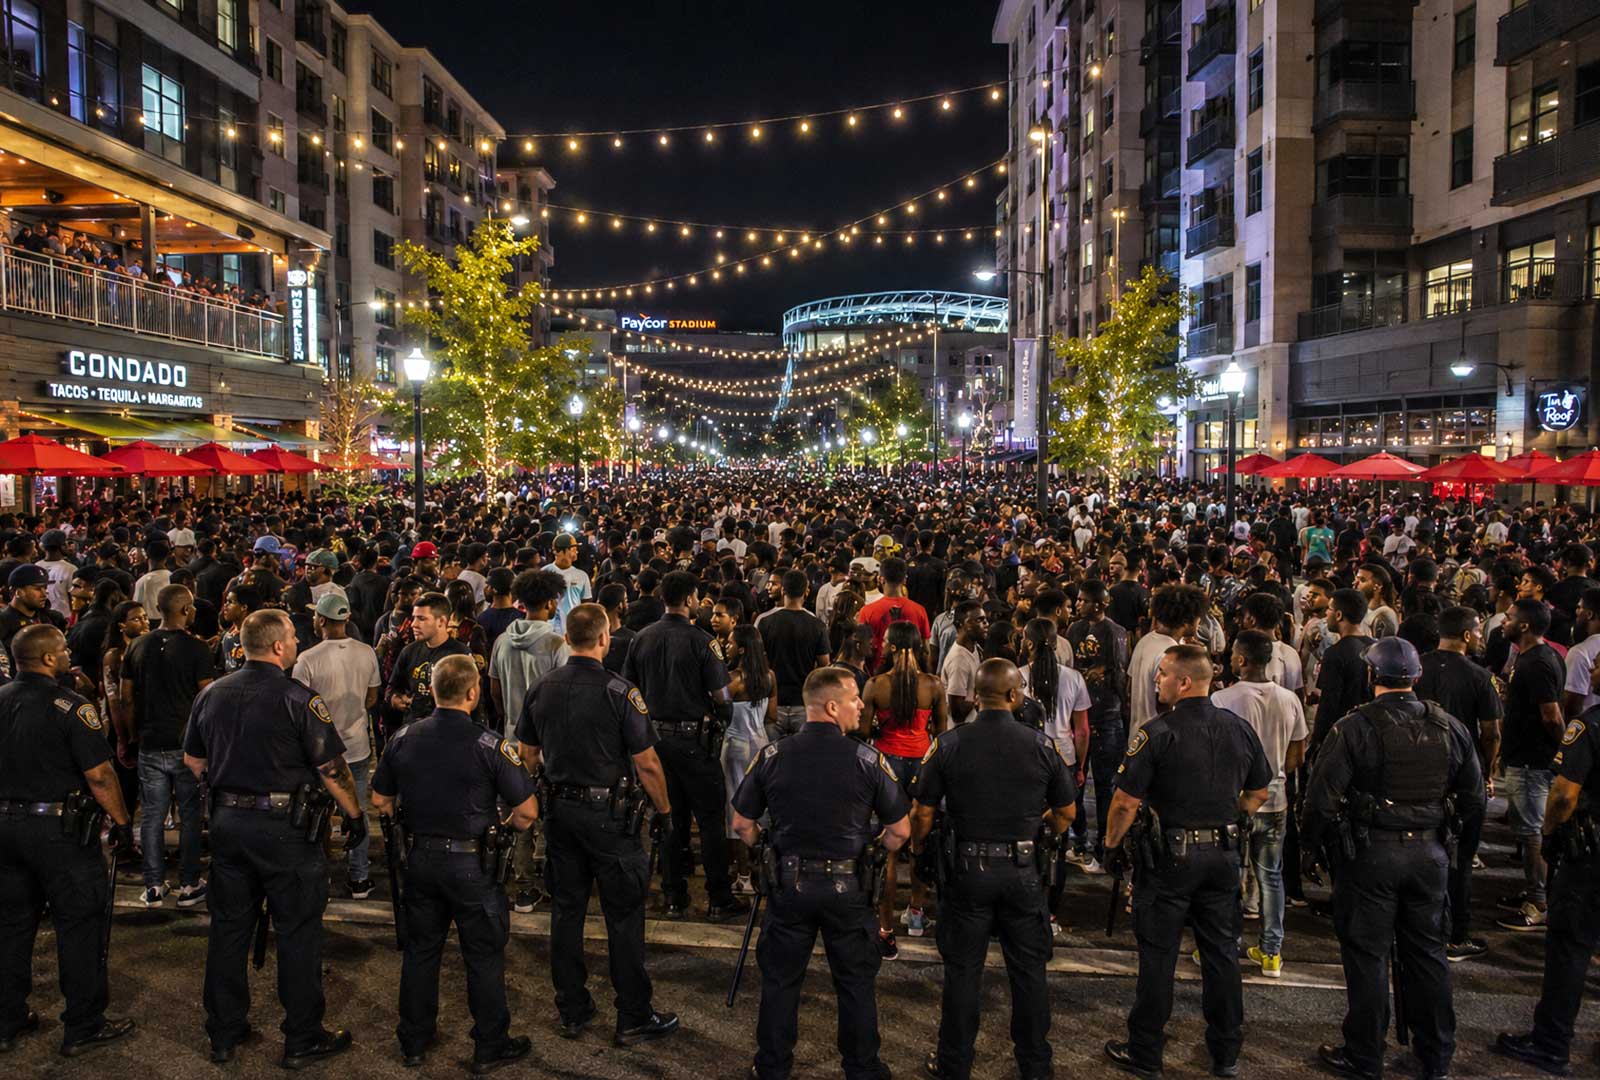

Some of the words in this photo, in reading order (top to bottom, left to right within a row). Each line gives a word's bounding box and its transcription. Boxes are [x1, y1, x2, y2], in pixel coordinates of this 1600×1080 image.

[621, 313, 667, 331] Paycor
[668, 320, 716, 329] STADIUM
[69, 350, 187, 388] CONDADO
[50, 383, 89, 399] TACOS
[97, 387, 141, 404] TEQUILA
[148, 392, 203, 409] MARGARITAS
[1540, 393, 1561, 407] Tin
[1544, 407, 1575, 423] Roof
